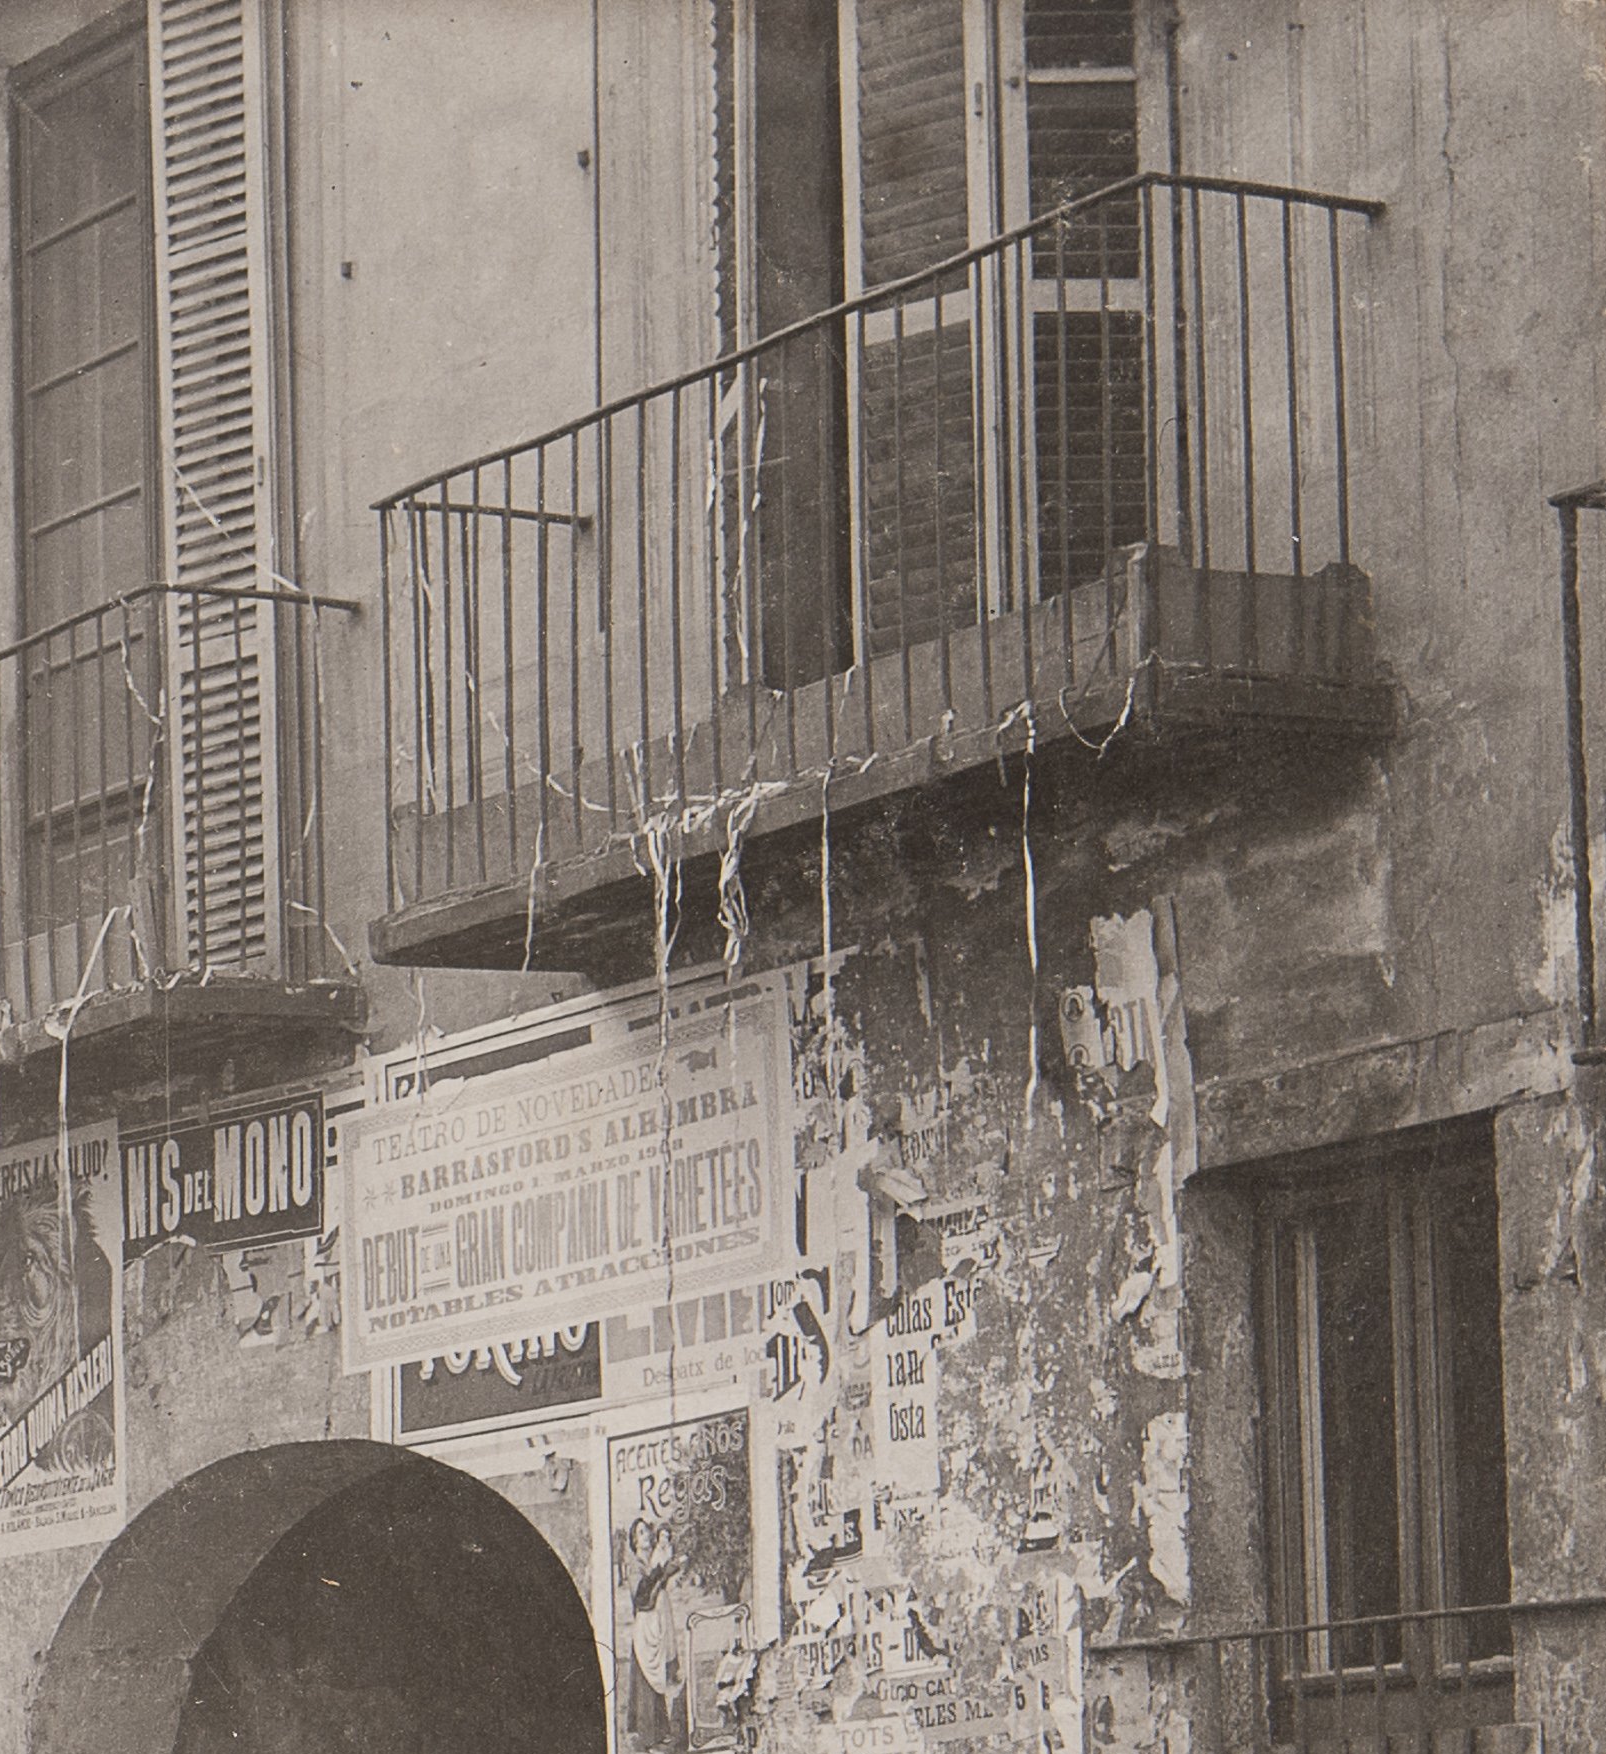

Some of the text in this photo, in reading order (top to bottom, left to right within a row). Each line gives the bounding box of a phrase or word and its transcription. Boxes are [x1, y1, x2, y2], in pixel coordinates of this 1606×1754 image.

[374, 1116, 466, 1165] TEATRO
[476, 1104, 507, 1138] DE
[54, 1138, 109, 1192] SLUD?
[184, 1169, 213, 1215] DEL
[213, 1110, 313, 1223] MONO
[429, 1180, 524, 1214] DOMINGO
[553, 1154, 630, 1184] MARZO
[455, 1204, 506, 1289] GRAN
[616, 1172, 642, 1252] DE
[361, 1225, 420, 1312] DEBUT
[368, 1283, 524, 1334] NOTABLES
[714, 1352, 733, 1372] de
[615, 1435, 681, 1482] ACEITES
